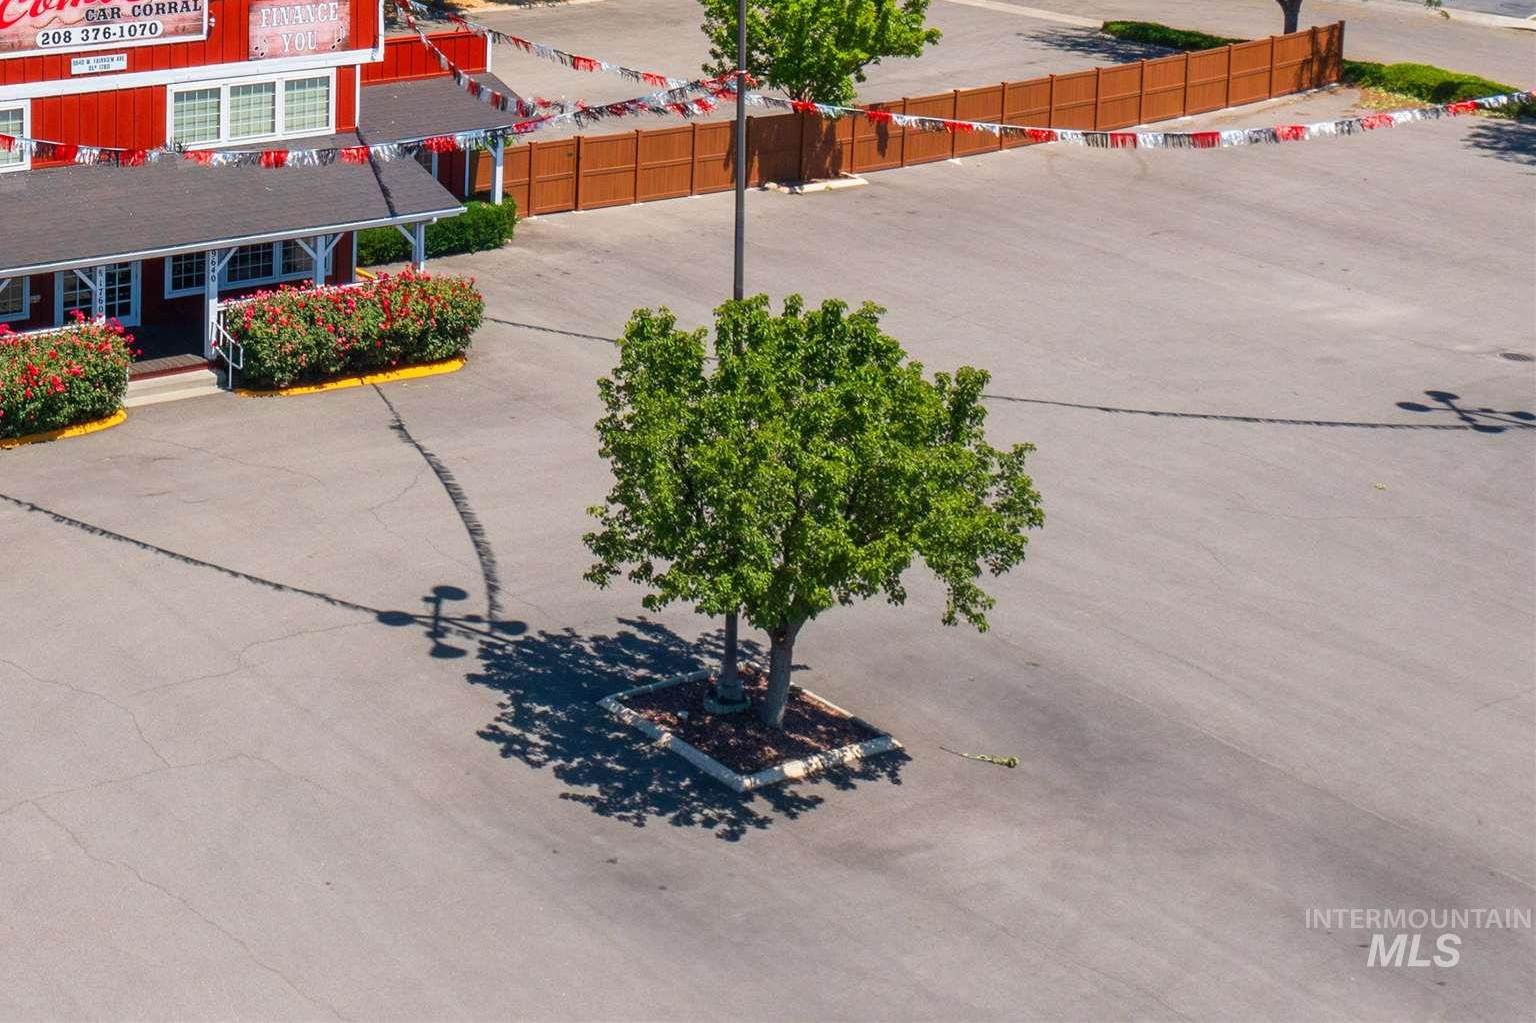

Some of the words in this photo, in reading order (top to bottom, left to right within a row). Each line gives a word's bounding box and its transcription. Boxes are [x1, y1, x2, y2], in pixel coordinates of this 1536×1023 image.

[85, 6, 122, 22] CAR
[131, 0, 202, 17] CORRAL
[261, 2, 339, 27] FINANCE
[41, 30, 73, 45] 208
[281, 31, 317, 53] YOU
